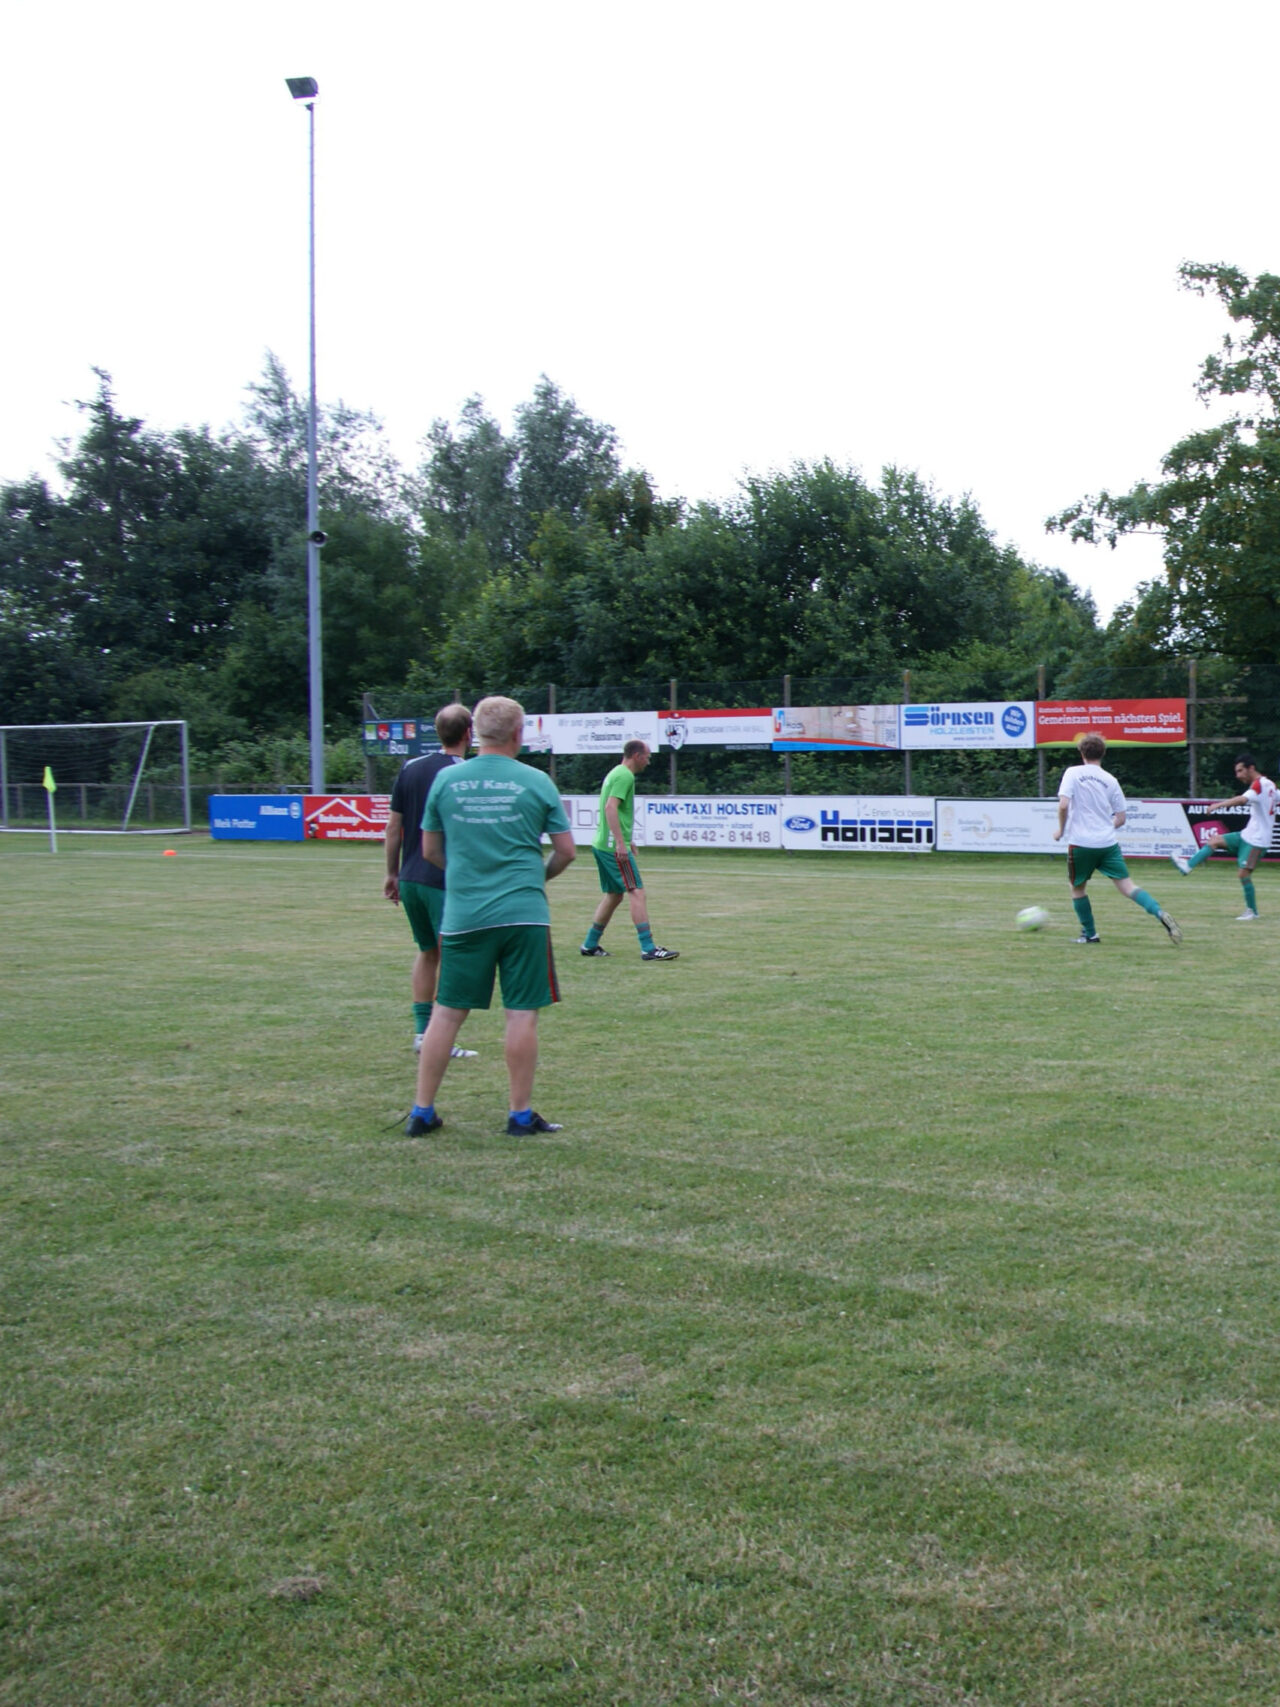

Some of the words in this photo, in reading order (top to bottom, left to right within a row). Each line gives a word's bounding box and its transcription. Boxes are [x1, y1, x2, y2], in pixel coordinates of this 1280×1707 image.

[604, 716, 624, 727] Gewalt
[1038, 714, 1090, 725] Gemeinsam
[1092, 716, 1112, 724] zum
[1114, 713, 1156, 724] nächsten
[1158, 712, 1183, 726] Spiel.
[590, 731, 622, 742] Rassismus
[930, 727, 995, 736] HOLZLEISTEN
[450, 779, 480, 793] TSV
[483, 779, 526, 795] Karby
[647, 803, 712, 816] FUNK-TAXI
[717, 803, 777, 816] HOLSTEIN
[671, 830, 678, 842] 0
[682, 830, 697, 842] 46
[701, 830, 716, 842] 42
[728, 831, 736, 842] 8
[739, 831, 753, 843] 14
[757, 831, 771, 843] 18
